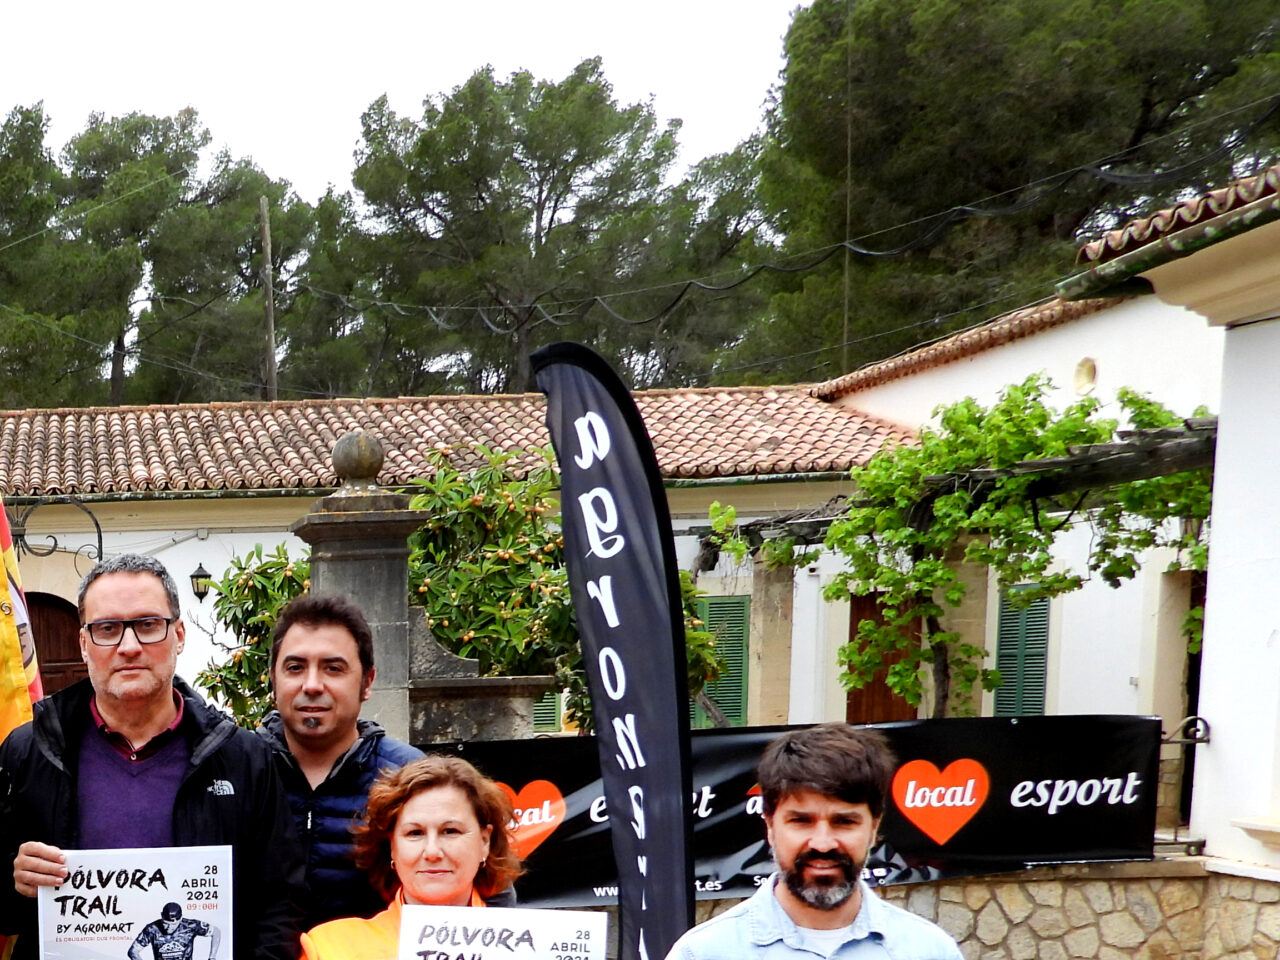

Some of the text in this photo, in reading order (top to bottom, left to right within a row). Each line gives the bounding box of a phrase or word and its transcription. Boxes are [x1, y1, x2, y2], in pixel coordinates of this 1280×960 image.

[904, 771, 1142, 815] local esport
[509, 800, 555, 829] cal
[204, 865, 218, 875] 28
[181, 879, 219, 888] ABRIL
[187, 890, 218, 900] 2024
[54, 895, 122, 919] TRAIL
[57, 922, 135, 936] BY AGROMART
[576, 930, 590, 940] 28
[418, 921, 536, 951] PÓLVORA
[550, 942, 590, 953] ABRIL
